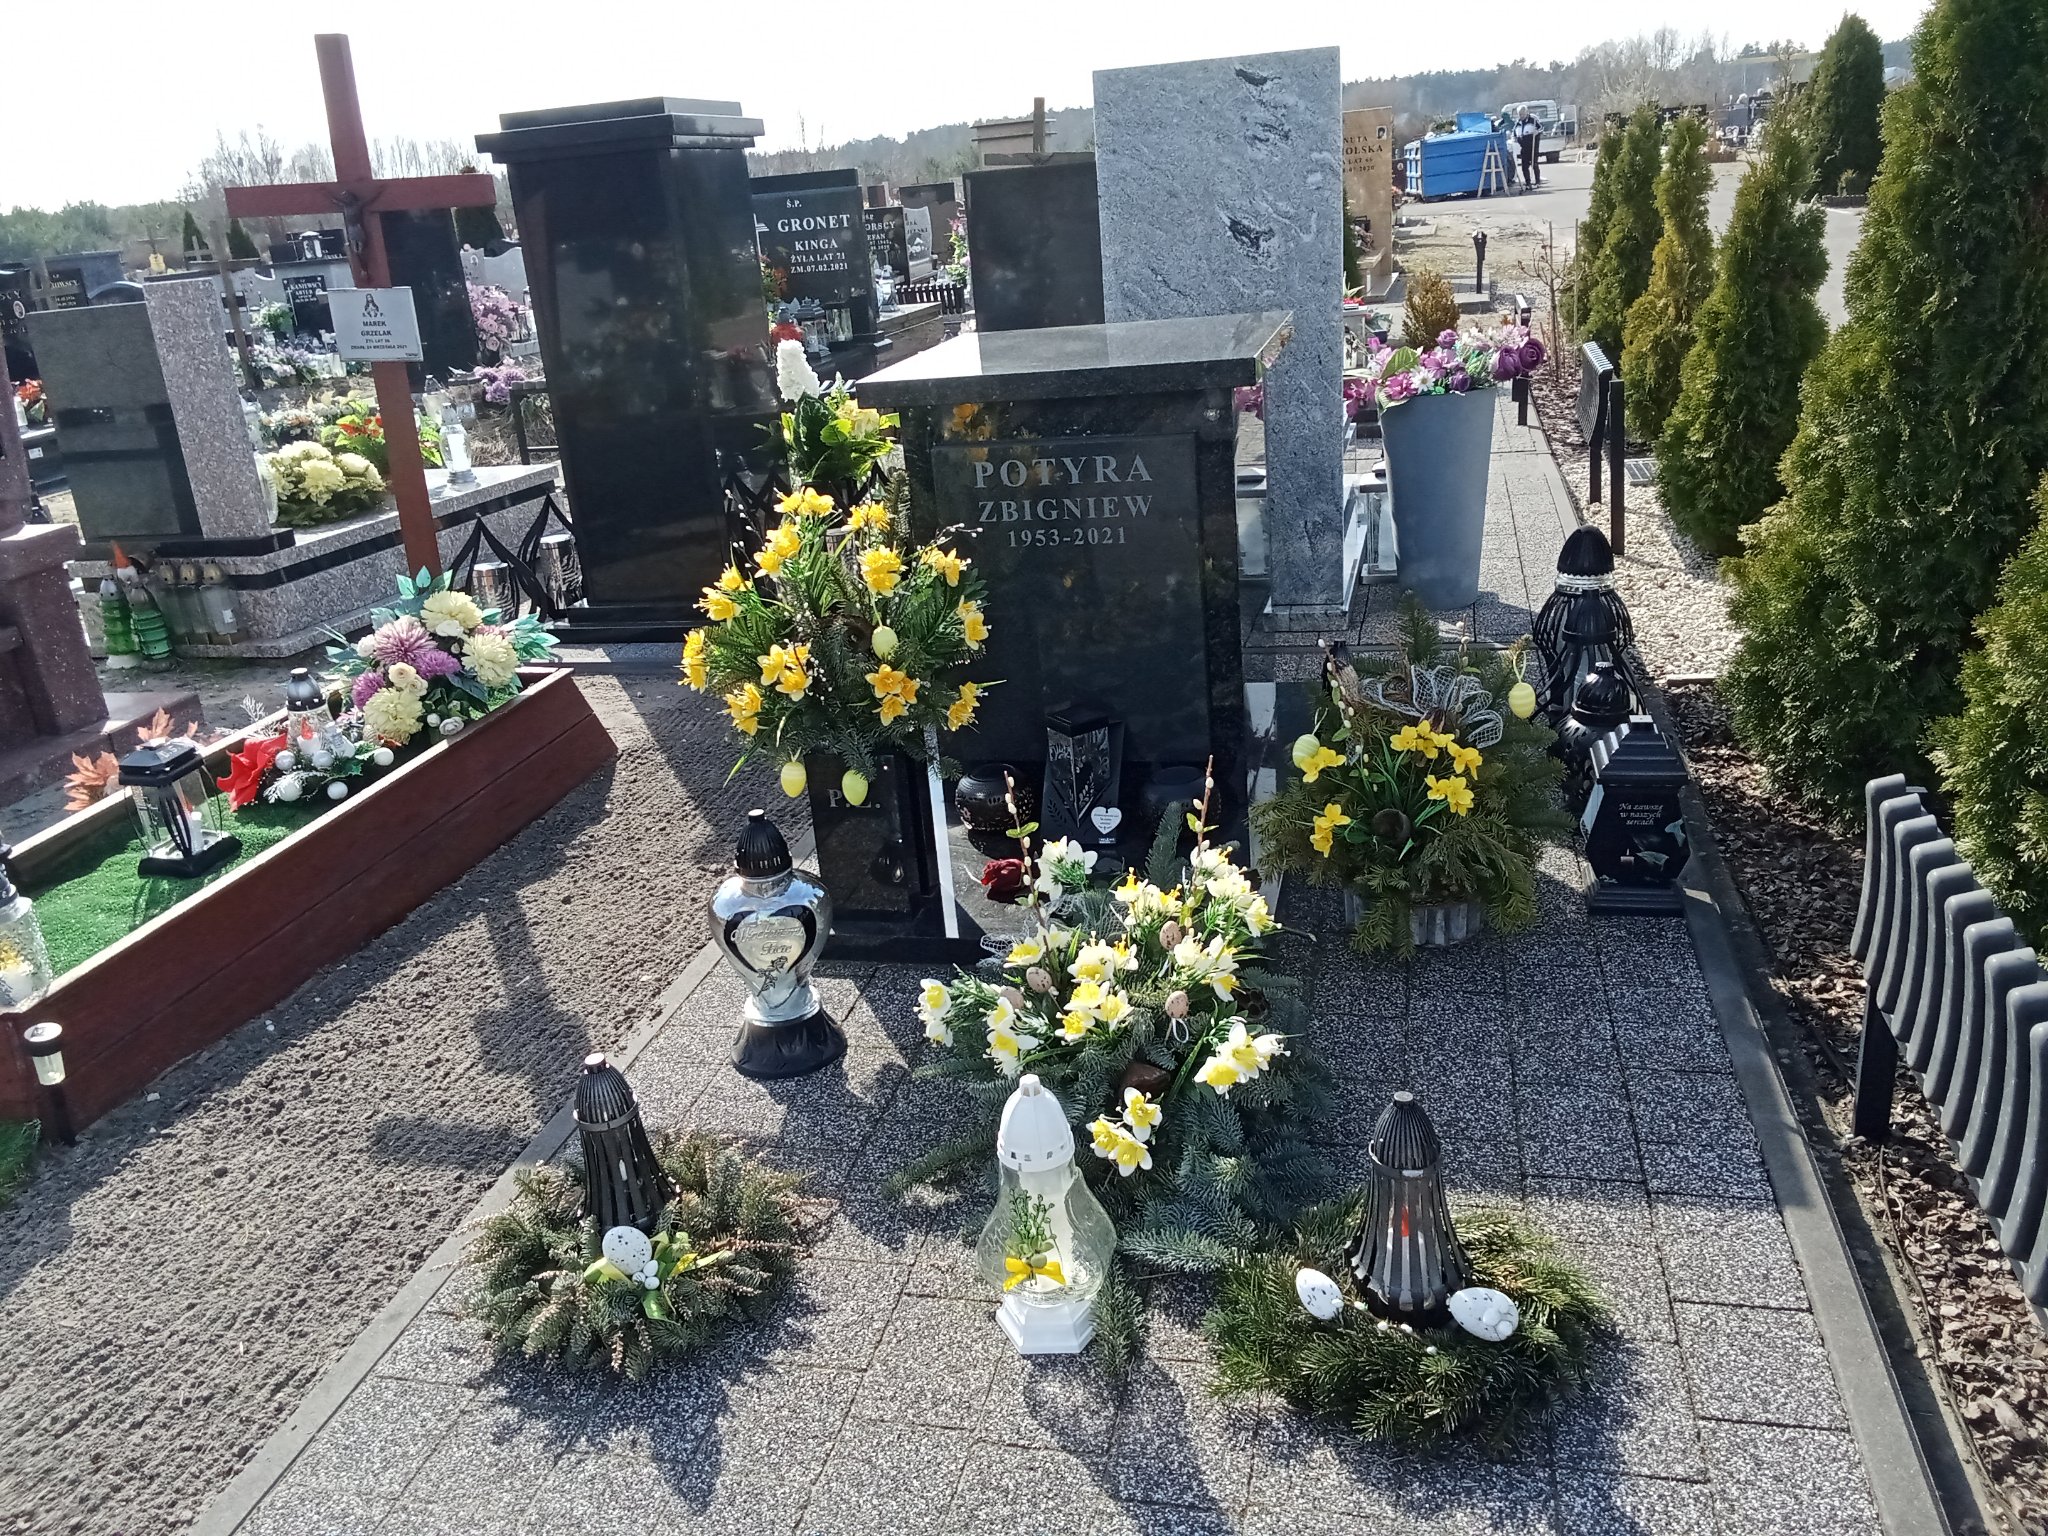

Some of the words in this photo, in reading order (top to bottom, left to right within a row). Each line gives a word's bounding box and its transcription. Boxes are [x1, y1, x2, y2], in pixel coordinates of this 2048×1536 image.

[1342, 144, 1383, 155] OLSKA
[777, 213, 850, 233] GRONET
[864, 221, 896, 231] ORSCY
[866, 233, 886, 241] EFAN
[794, 238, 838, 251] KINGA
[790, 253, 815, 263] ŻYŁA
[817, 253, 834, 261] LAT
[974, 453, 1153, 489] POTYRA
[978, 495, 1153, 522] ZBIGNIEW
[1008, 526, 1126, 547] 1953-2021
[1630, 810, 1661, 820] naszych
[1626, 817, 1654, 825] sercach
